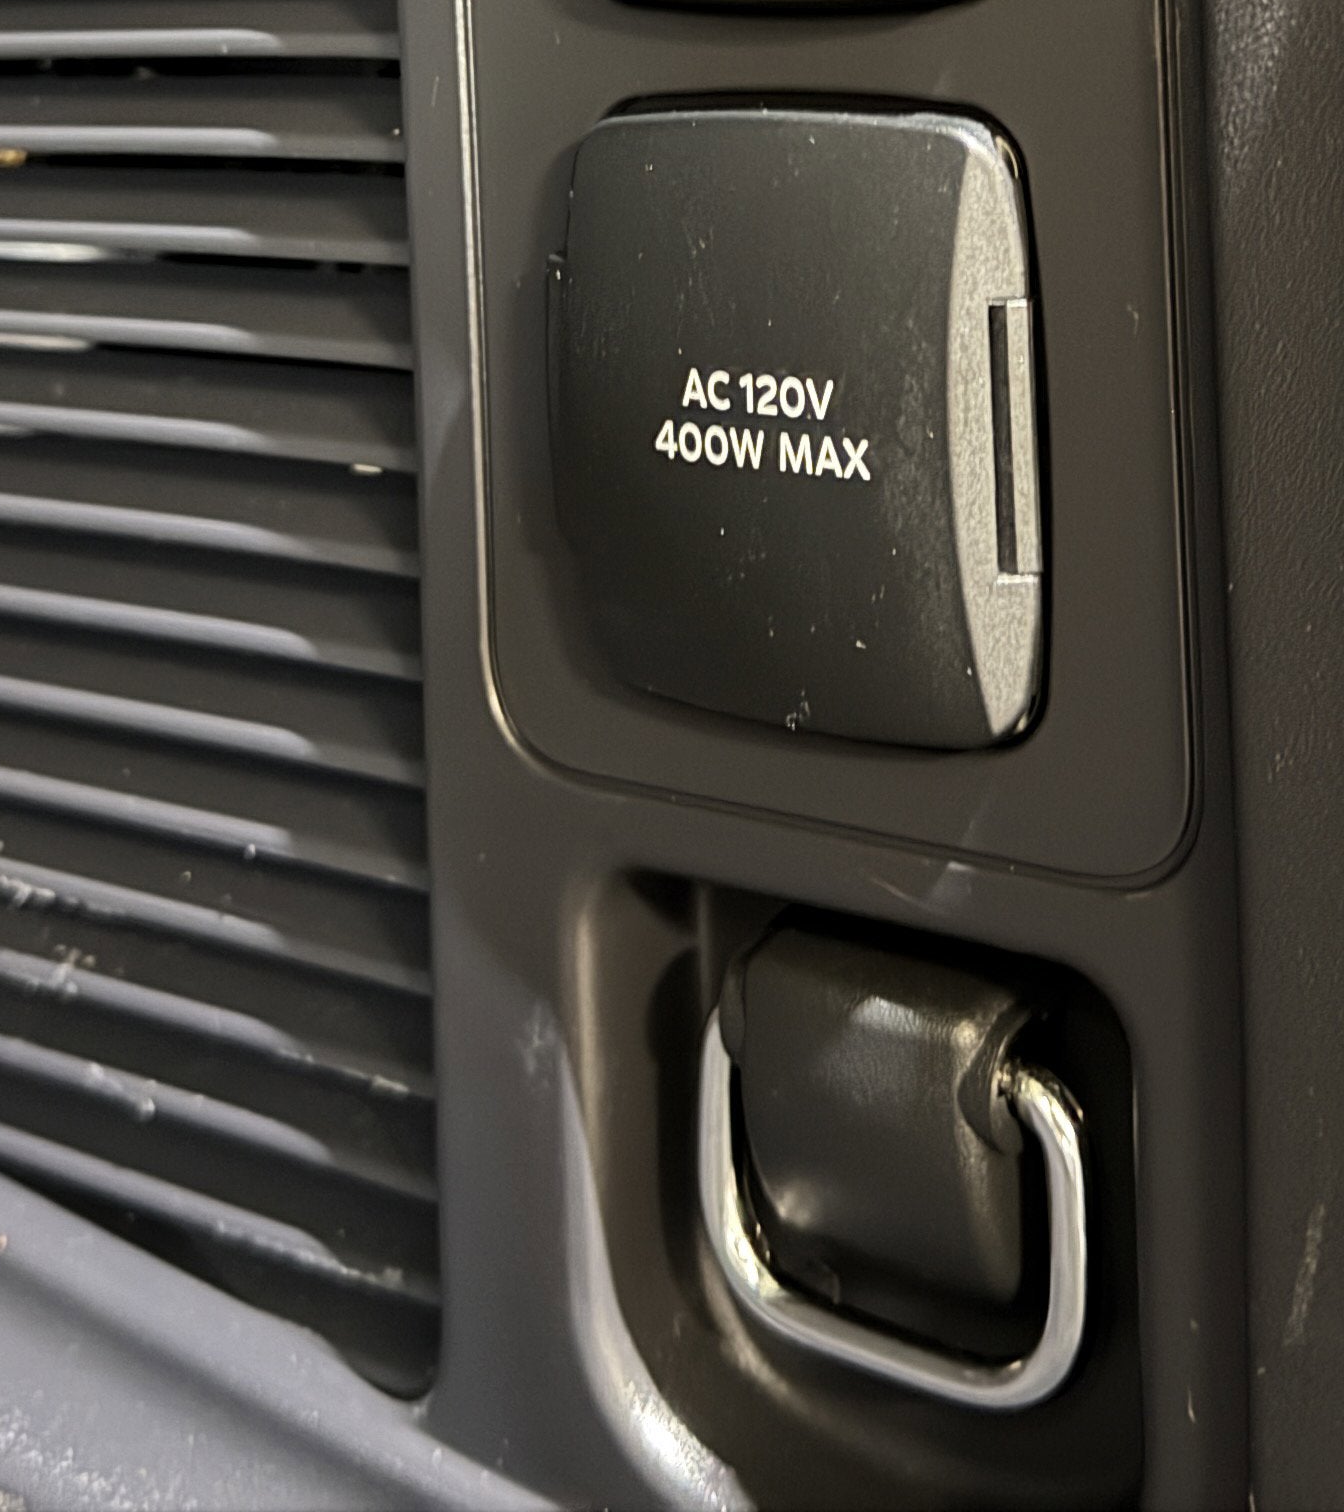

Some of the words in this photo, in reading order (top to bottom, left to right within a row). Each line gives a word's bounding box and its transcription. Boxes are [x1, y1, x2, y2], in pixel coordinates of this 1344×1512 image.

[682, 368, 731, 411] AC
[739, 373, 834, 420] 120V
[655, 419, 765, 470] 400W
[779, 431, 871, 481] MAX
